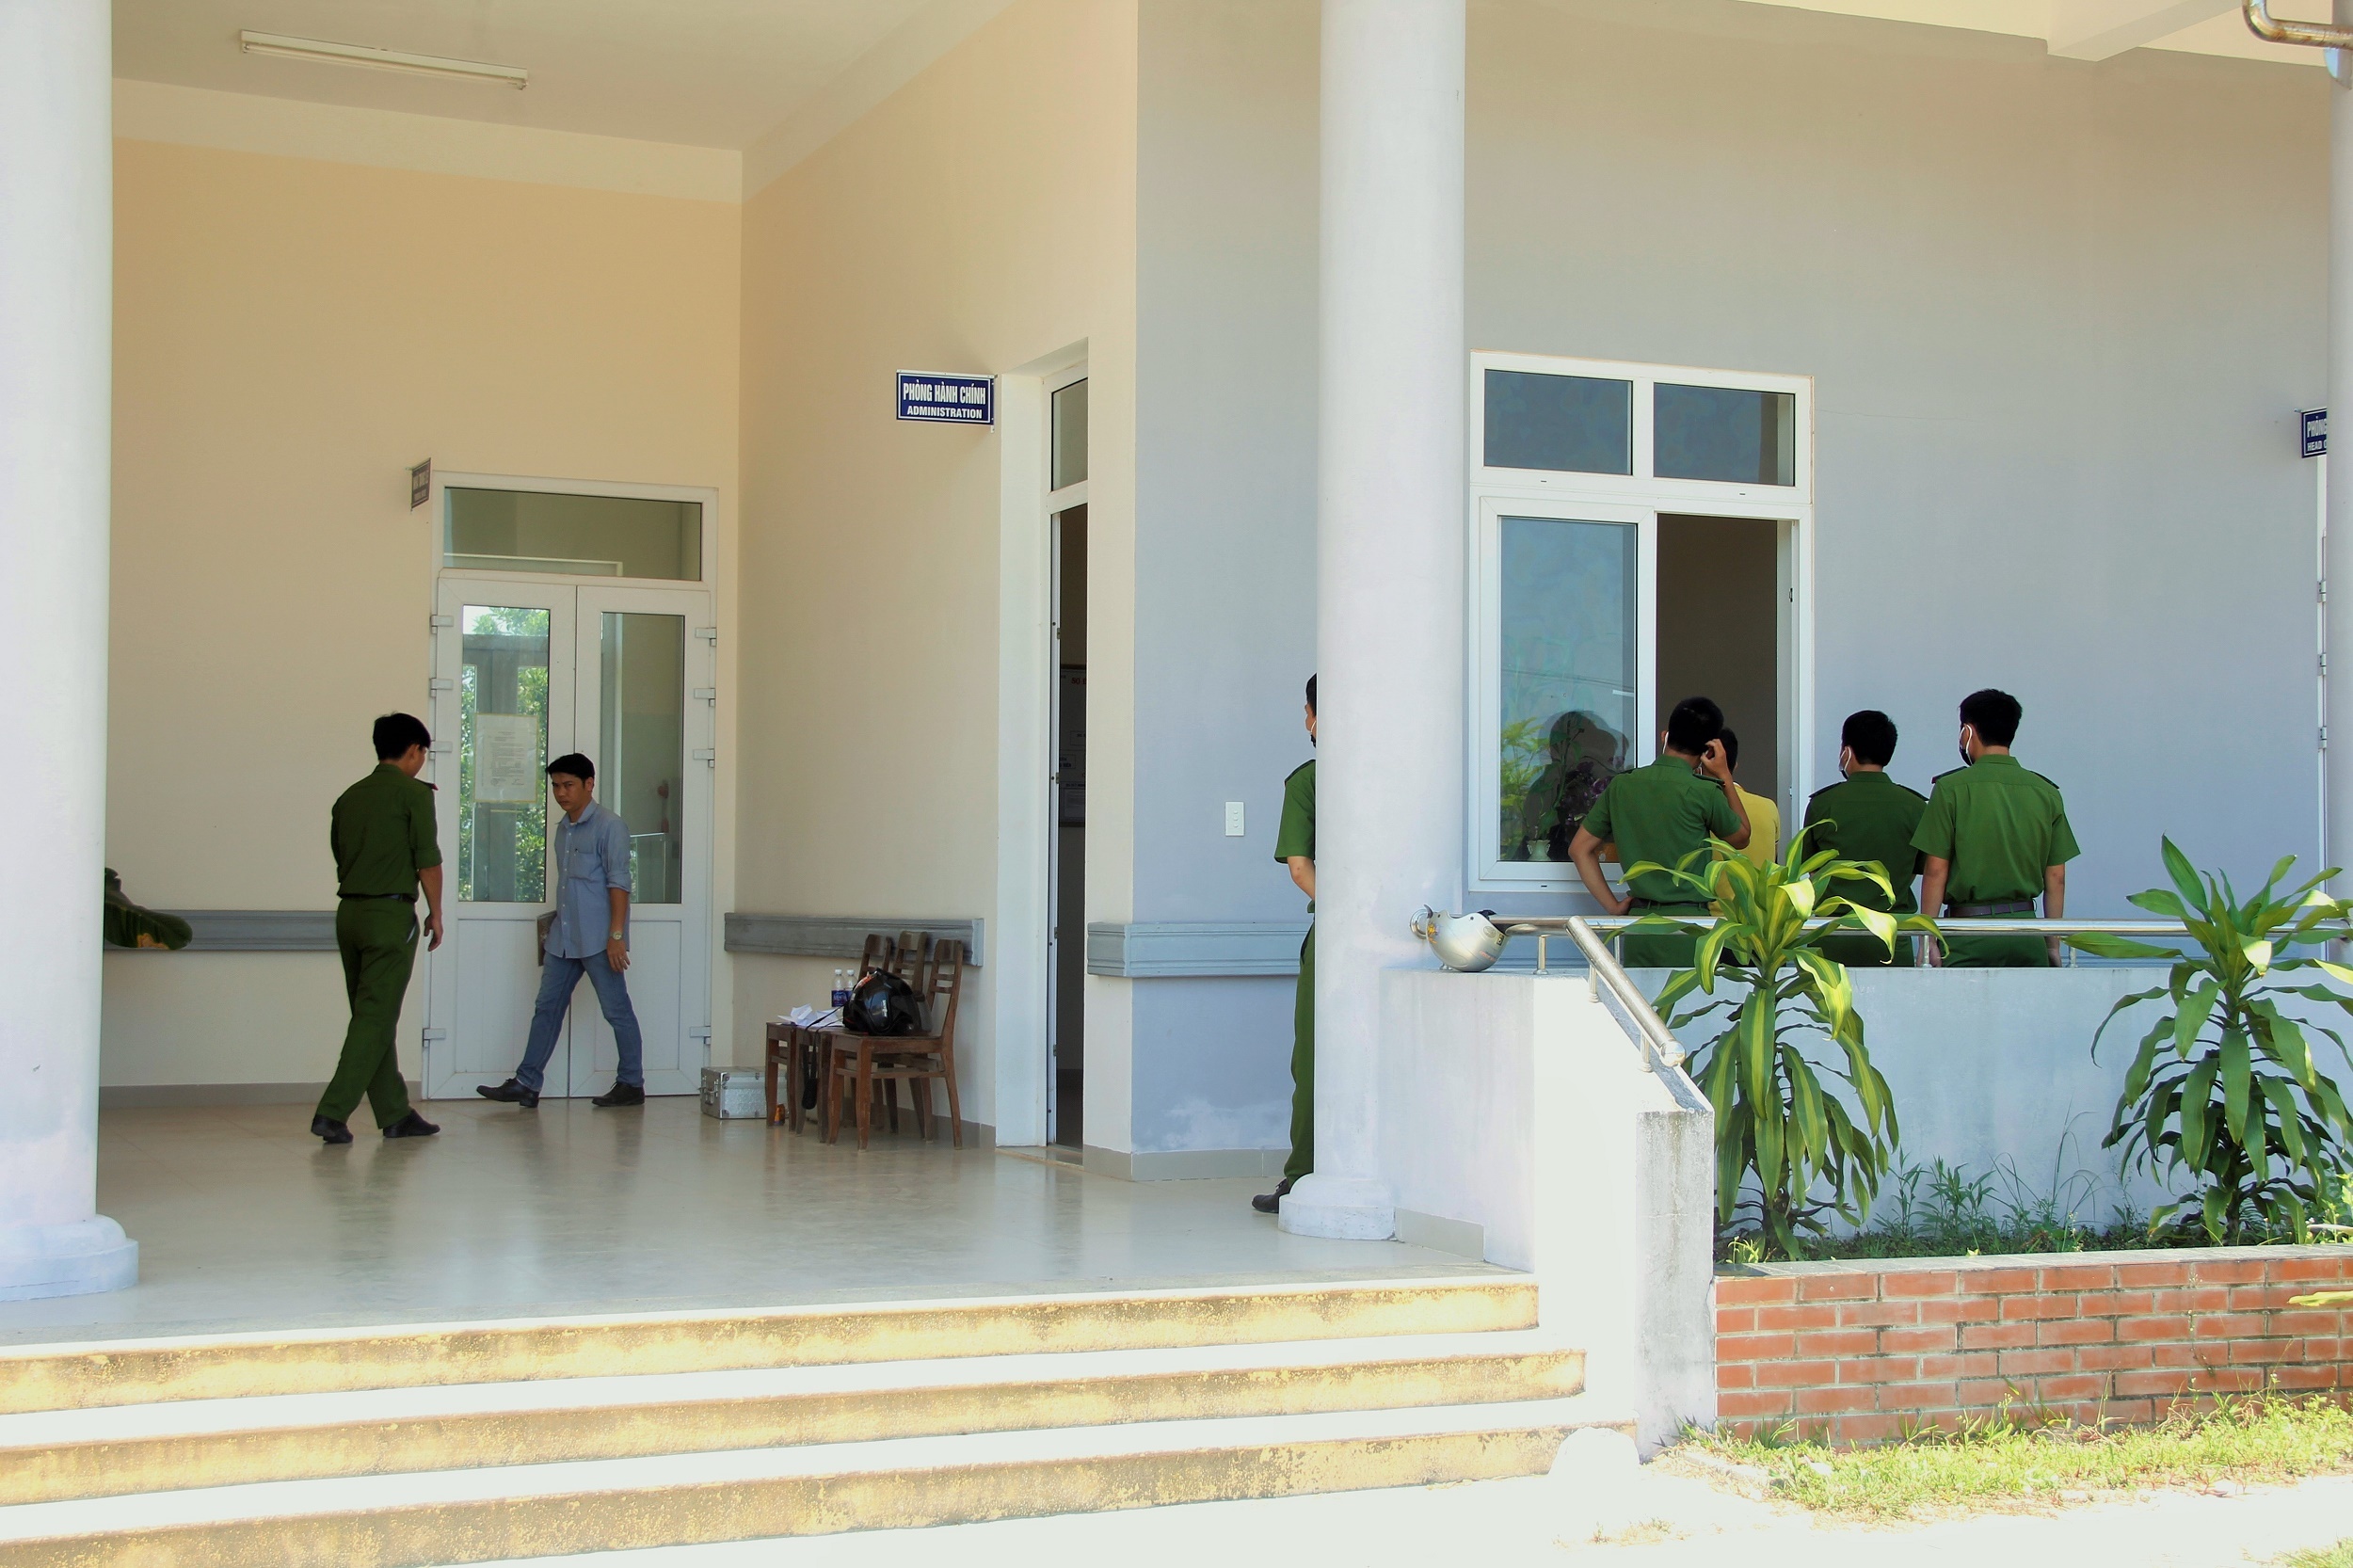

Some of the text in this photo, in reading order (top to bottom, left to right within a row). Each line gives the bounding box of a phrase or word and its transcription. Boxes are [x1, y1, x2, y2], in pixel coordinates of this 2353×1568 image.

[903, 379, 986, 405] PHÒNG HÀNH CHÍNH
[907, 405, 983, 419] ADMINISTRATION
